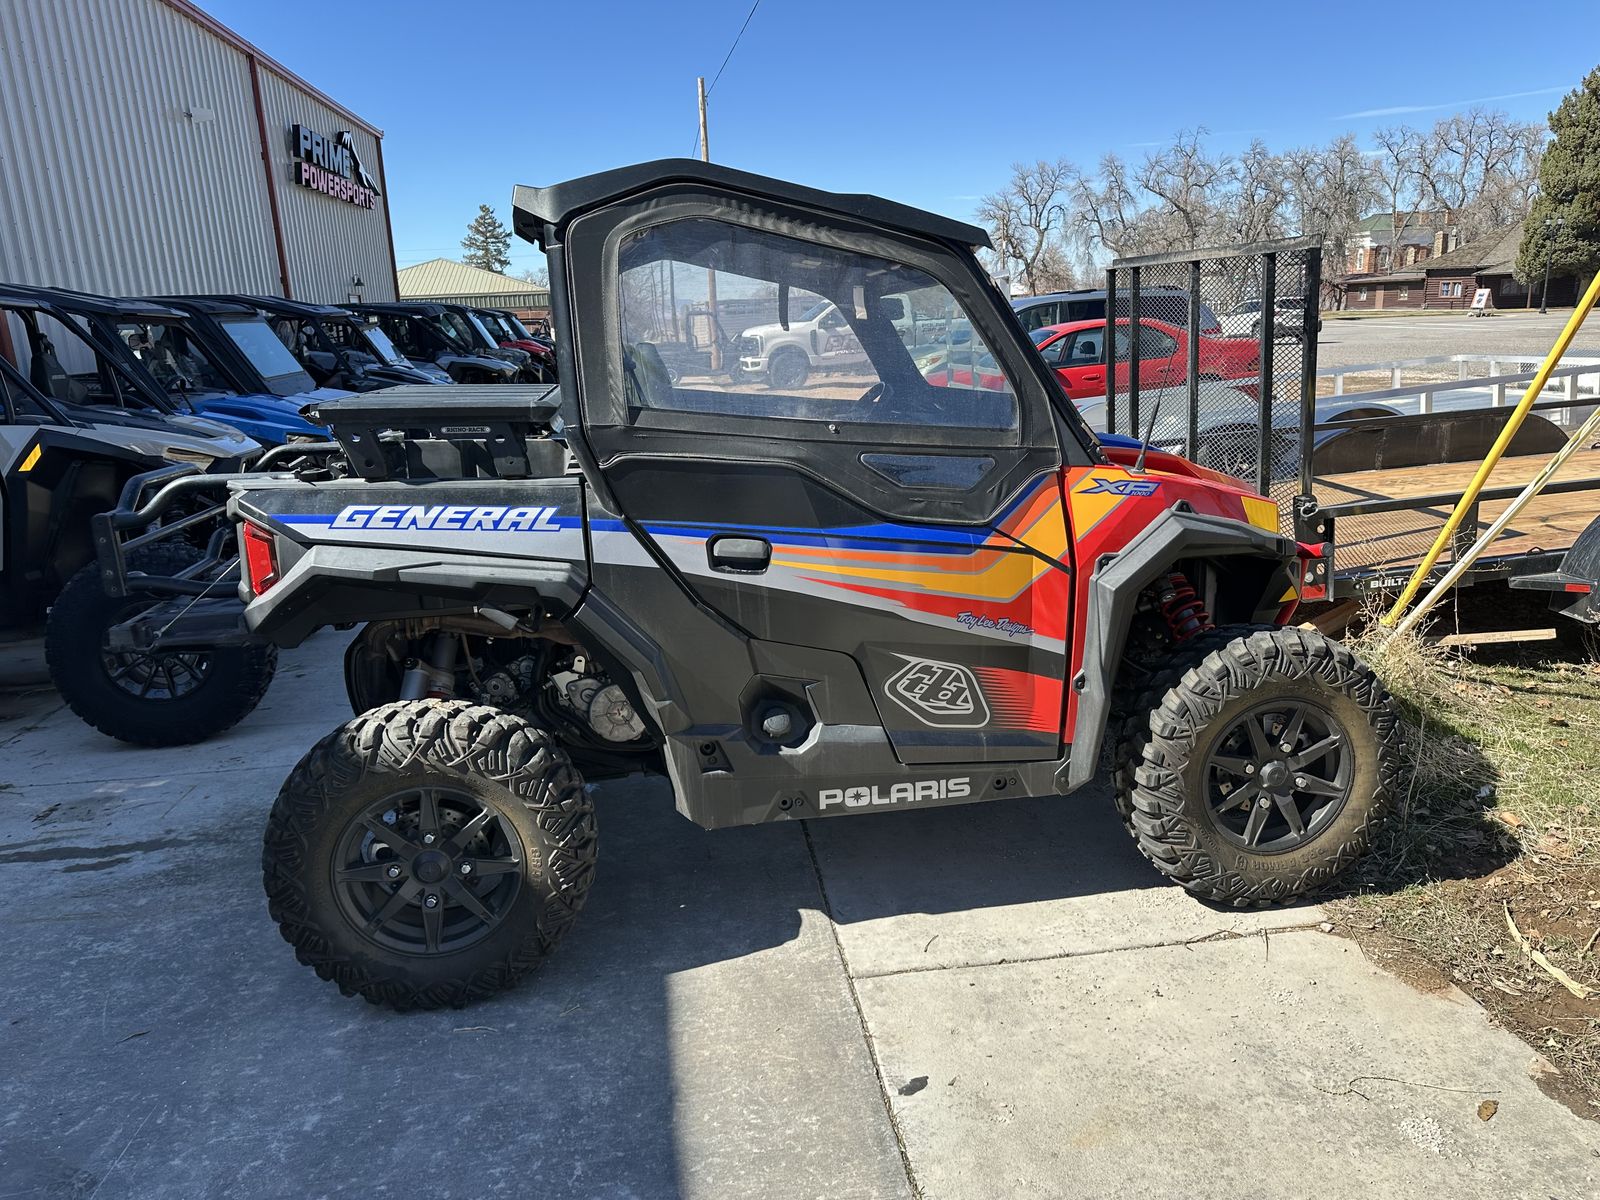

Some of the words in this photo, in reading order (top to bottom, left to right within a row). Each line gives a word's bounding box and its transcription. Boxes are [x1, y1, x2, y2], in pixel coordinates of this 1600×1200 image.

[299, 126, 352, 179] PRIME
[301, 162, 375, 210] POWERSPORTS
[1075, 478, 1161, 497] XP
[329, 504, 561, 532] GENERAL
[1370, 577, 1404, 588] BUILT
[957, 611, 977, 630] Troy
[978, 614, 995, 629] Lee
[995, 617, 1035, 637] Designs
[819, 777, 971, 810] POLARIS
